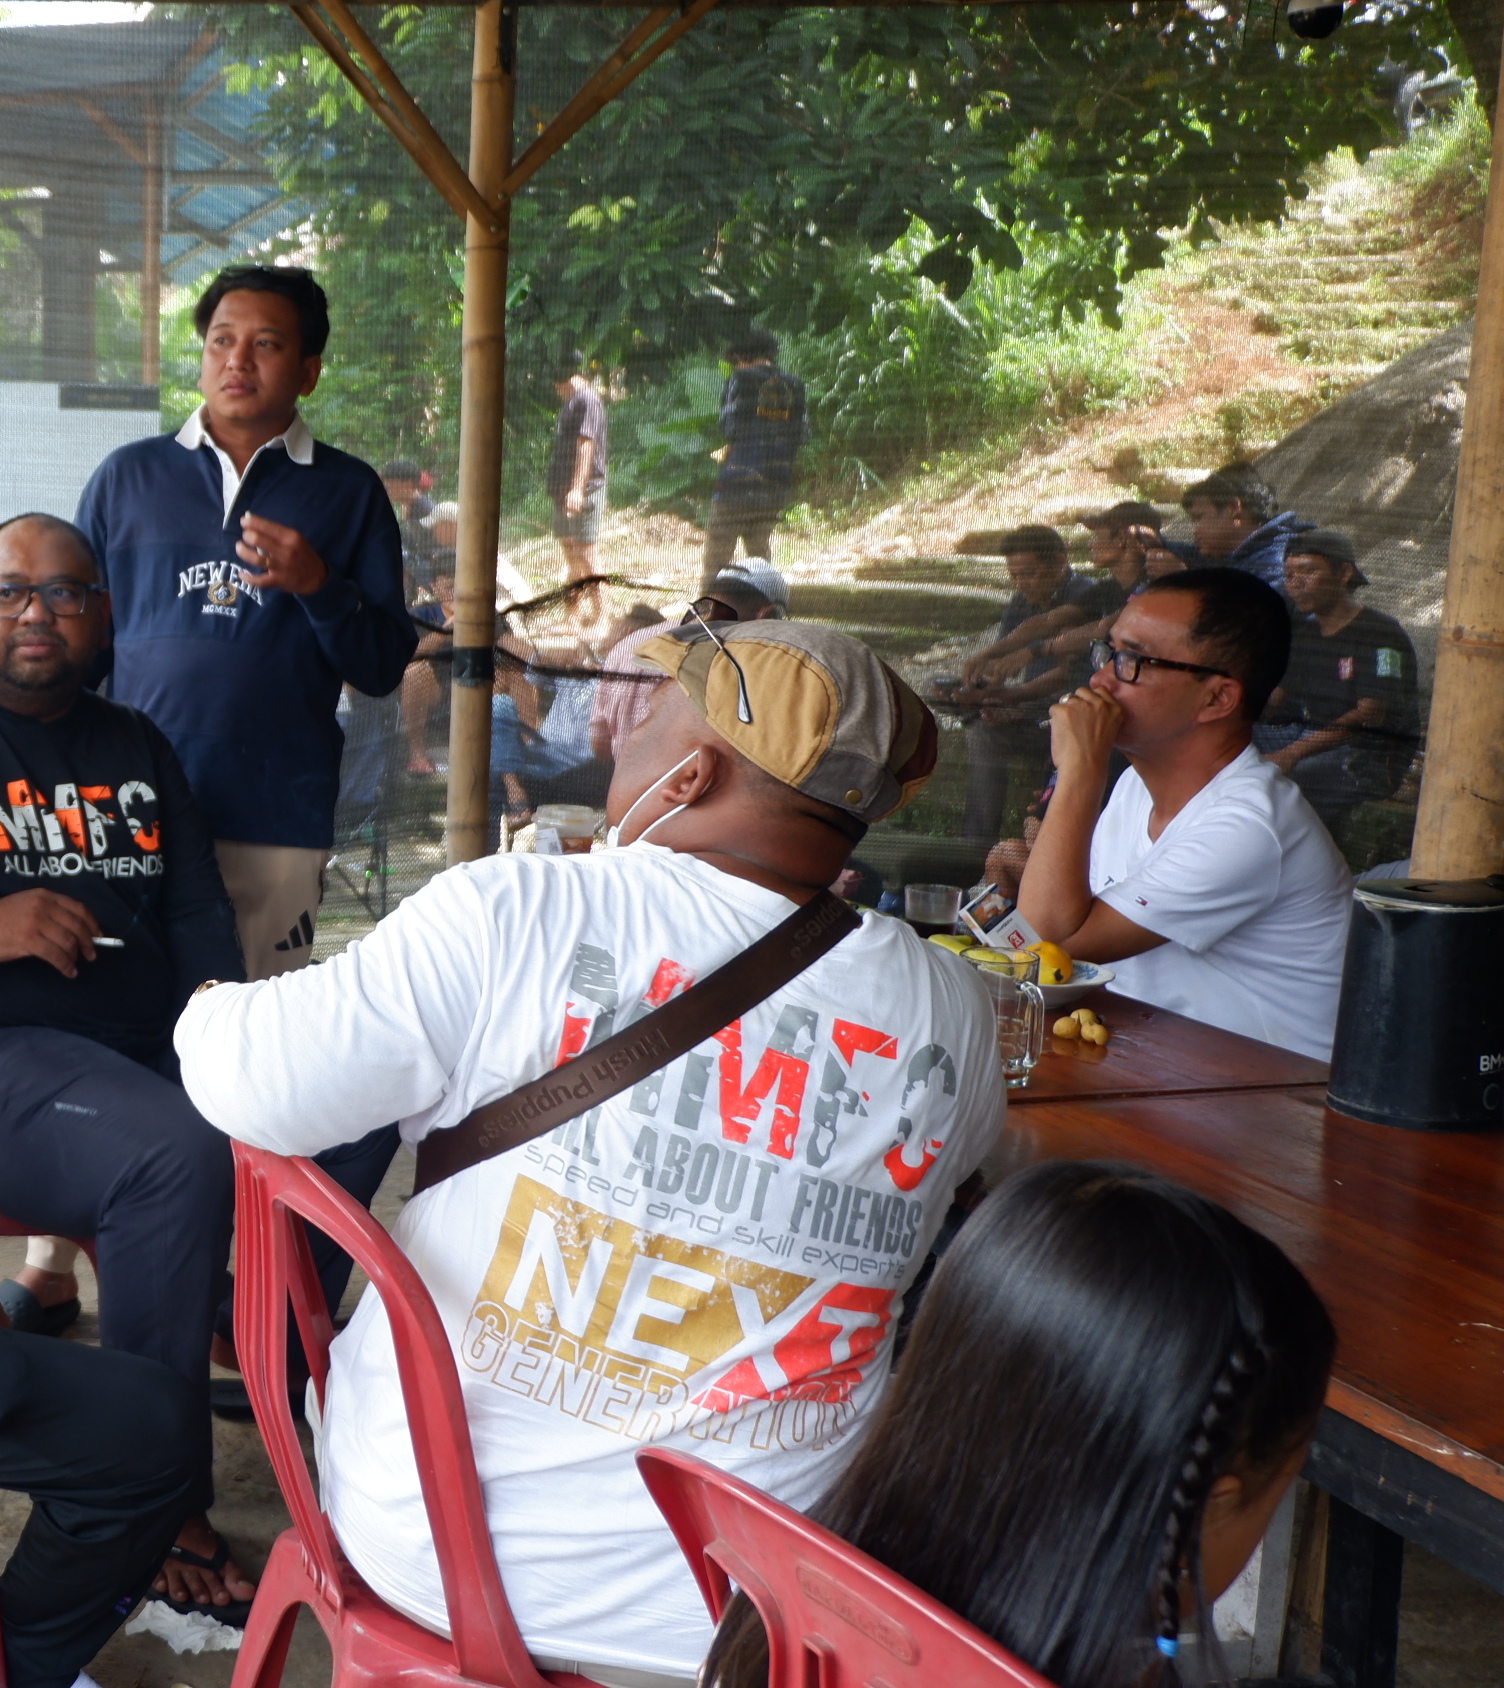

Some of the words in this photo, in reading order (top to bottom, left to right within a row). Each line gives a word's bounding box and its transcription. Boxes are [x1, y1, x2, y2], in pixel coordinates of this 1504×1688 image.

[178, 561, 228, 597] NEW
[201, 604, 238, 617] MCMXX
[4, 854, 35, 877] ALL
[592, 1027, 671, 1081] Hush
[1479, 1052, 1504, 1072] BM
[486, 1072, 595, 1139] Puppies
[539, 1105, 602, 1168] LL
[623, 1124, 779, 1222] ABOUT
[789, 1172, 923, 1260] FRIENDS
[524, 1143, 639, 1211] speed
[646, 1200, 725, 1236] and
[732, 1222, 794, 1258] skill
[801, 1245, 906, 1279] expert's
[502, 1207, 880, 1394] NEXT
